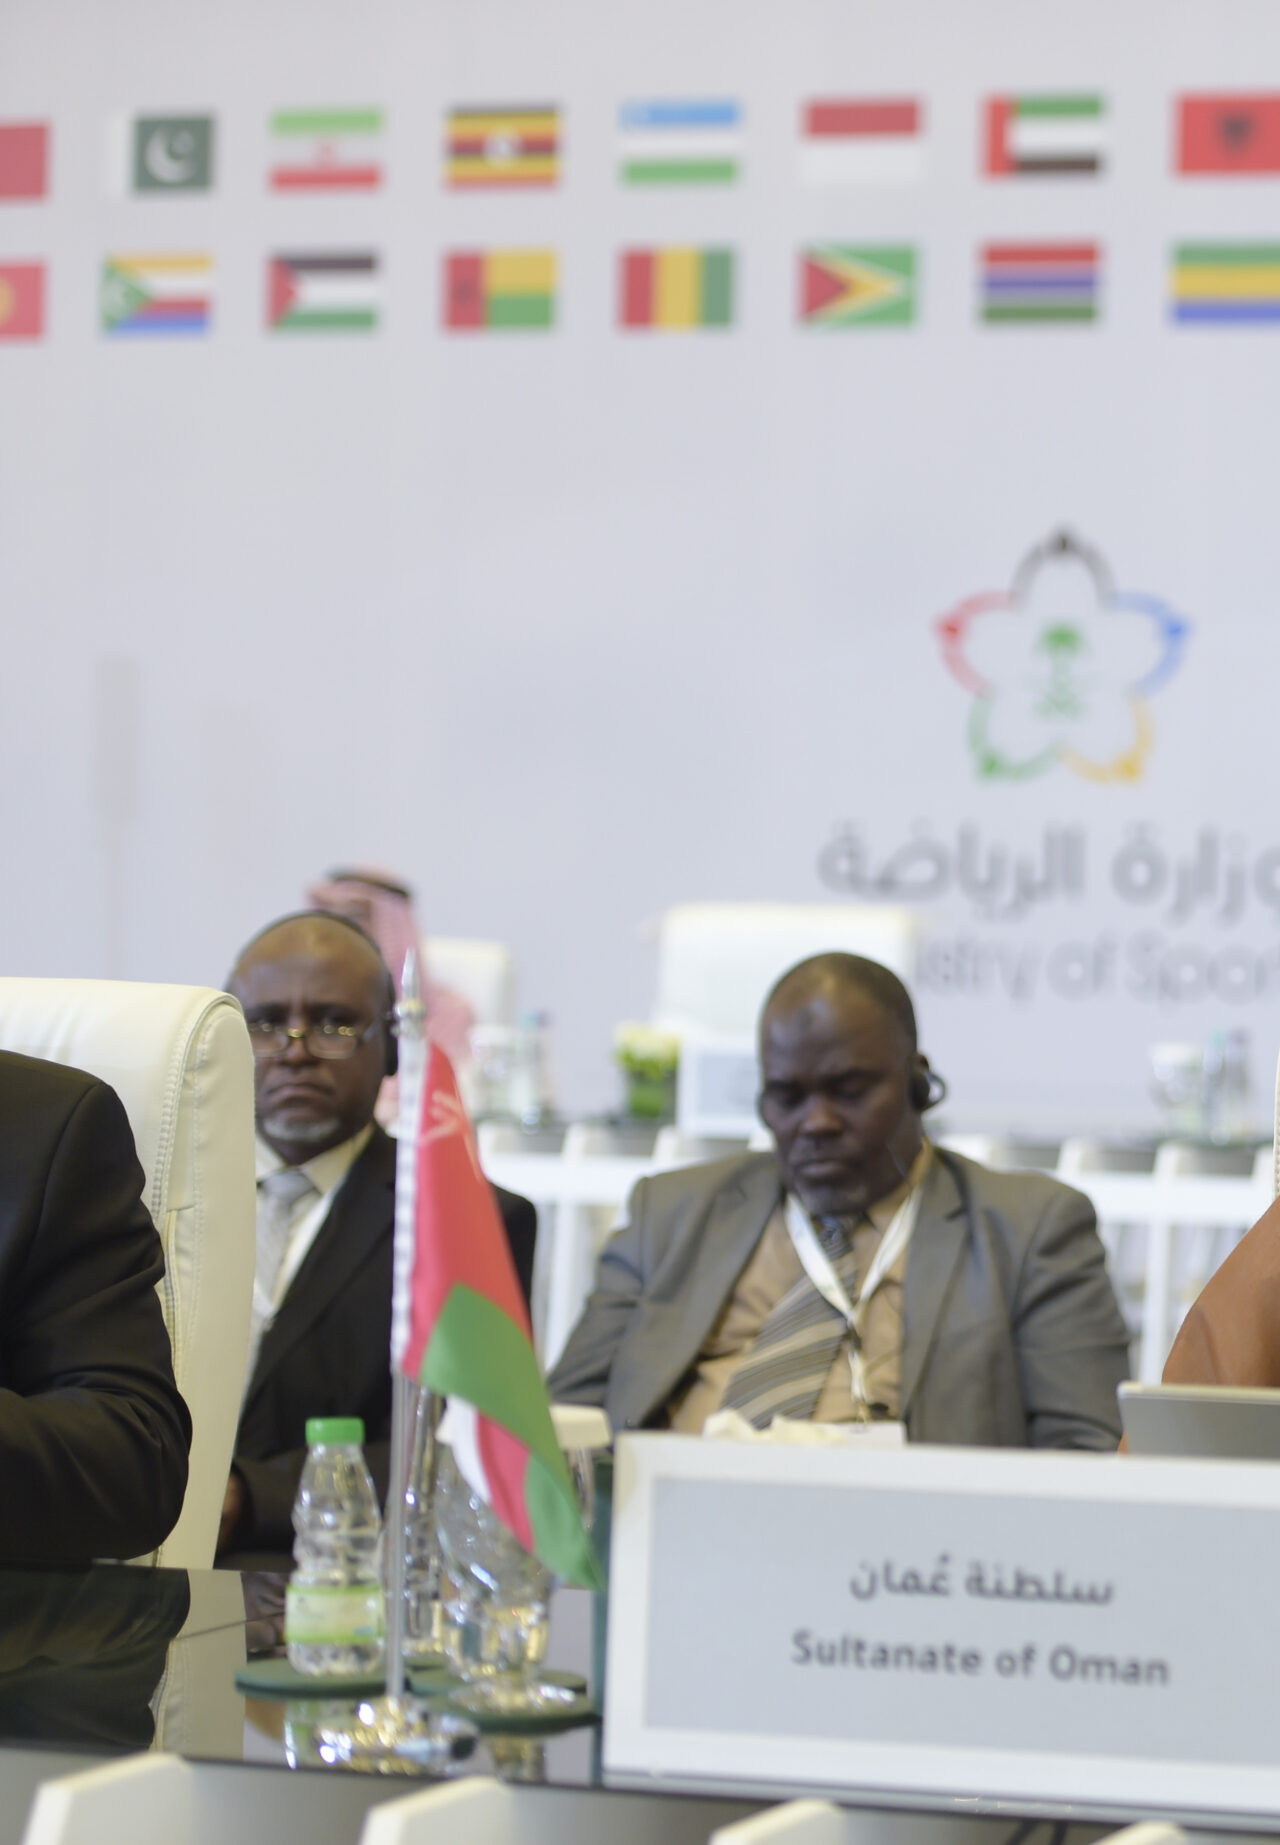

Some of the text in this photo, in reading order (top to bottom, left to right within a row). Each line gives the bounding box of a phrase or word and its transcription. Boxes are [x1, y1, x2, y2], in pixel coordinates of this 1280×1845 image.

[818, 818, 1086, 920] الرياضة
[914, 936, 1041, 1008] istry
[1045, 934, 1118, 1004] of
[849, 1552, 1114, 1606] سلطنة عُمان
[791, 1629, 1170, 1686] Sultanate of Oman
